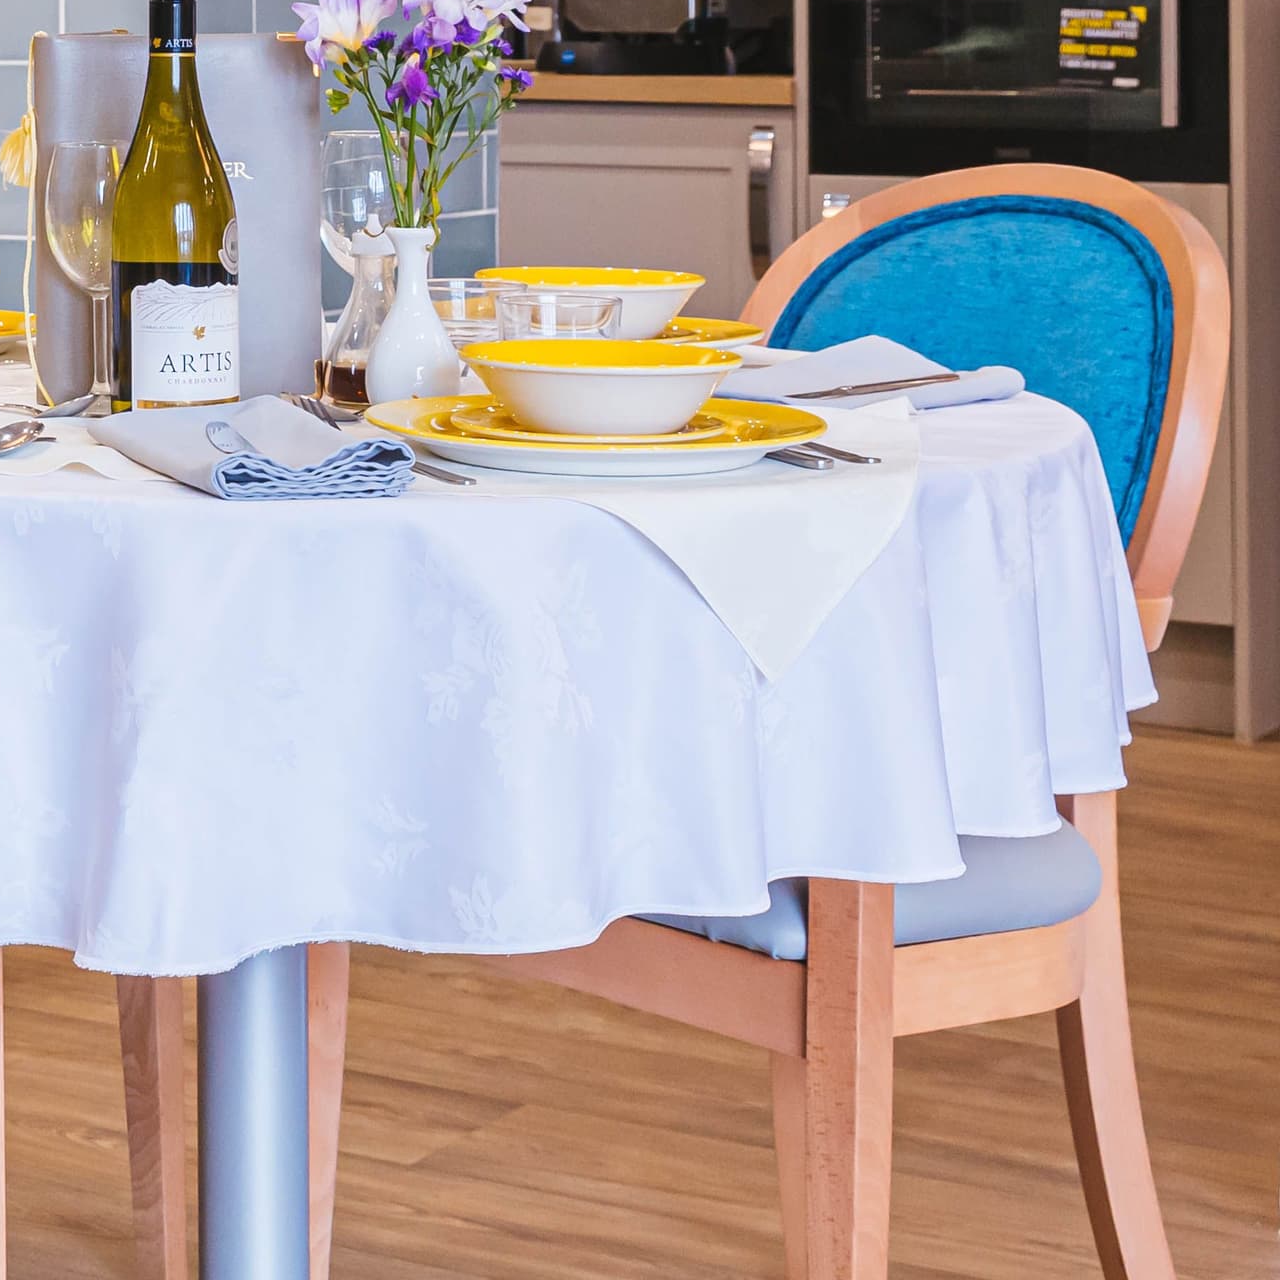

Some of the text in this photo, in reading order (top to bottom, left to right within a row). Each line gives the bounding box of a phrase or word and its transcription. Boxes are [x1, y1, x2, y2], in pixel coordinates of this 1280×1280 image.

[165, 38, 193, 48] ARTIS
[160, 351, 232, 373] ARTIS
[167, 376, 226, 385] CHARDONNAY
